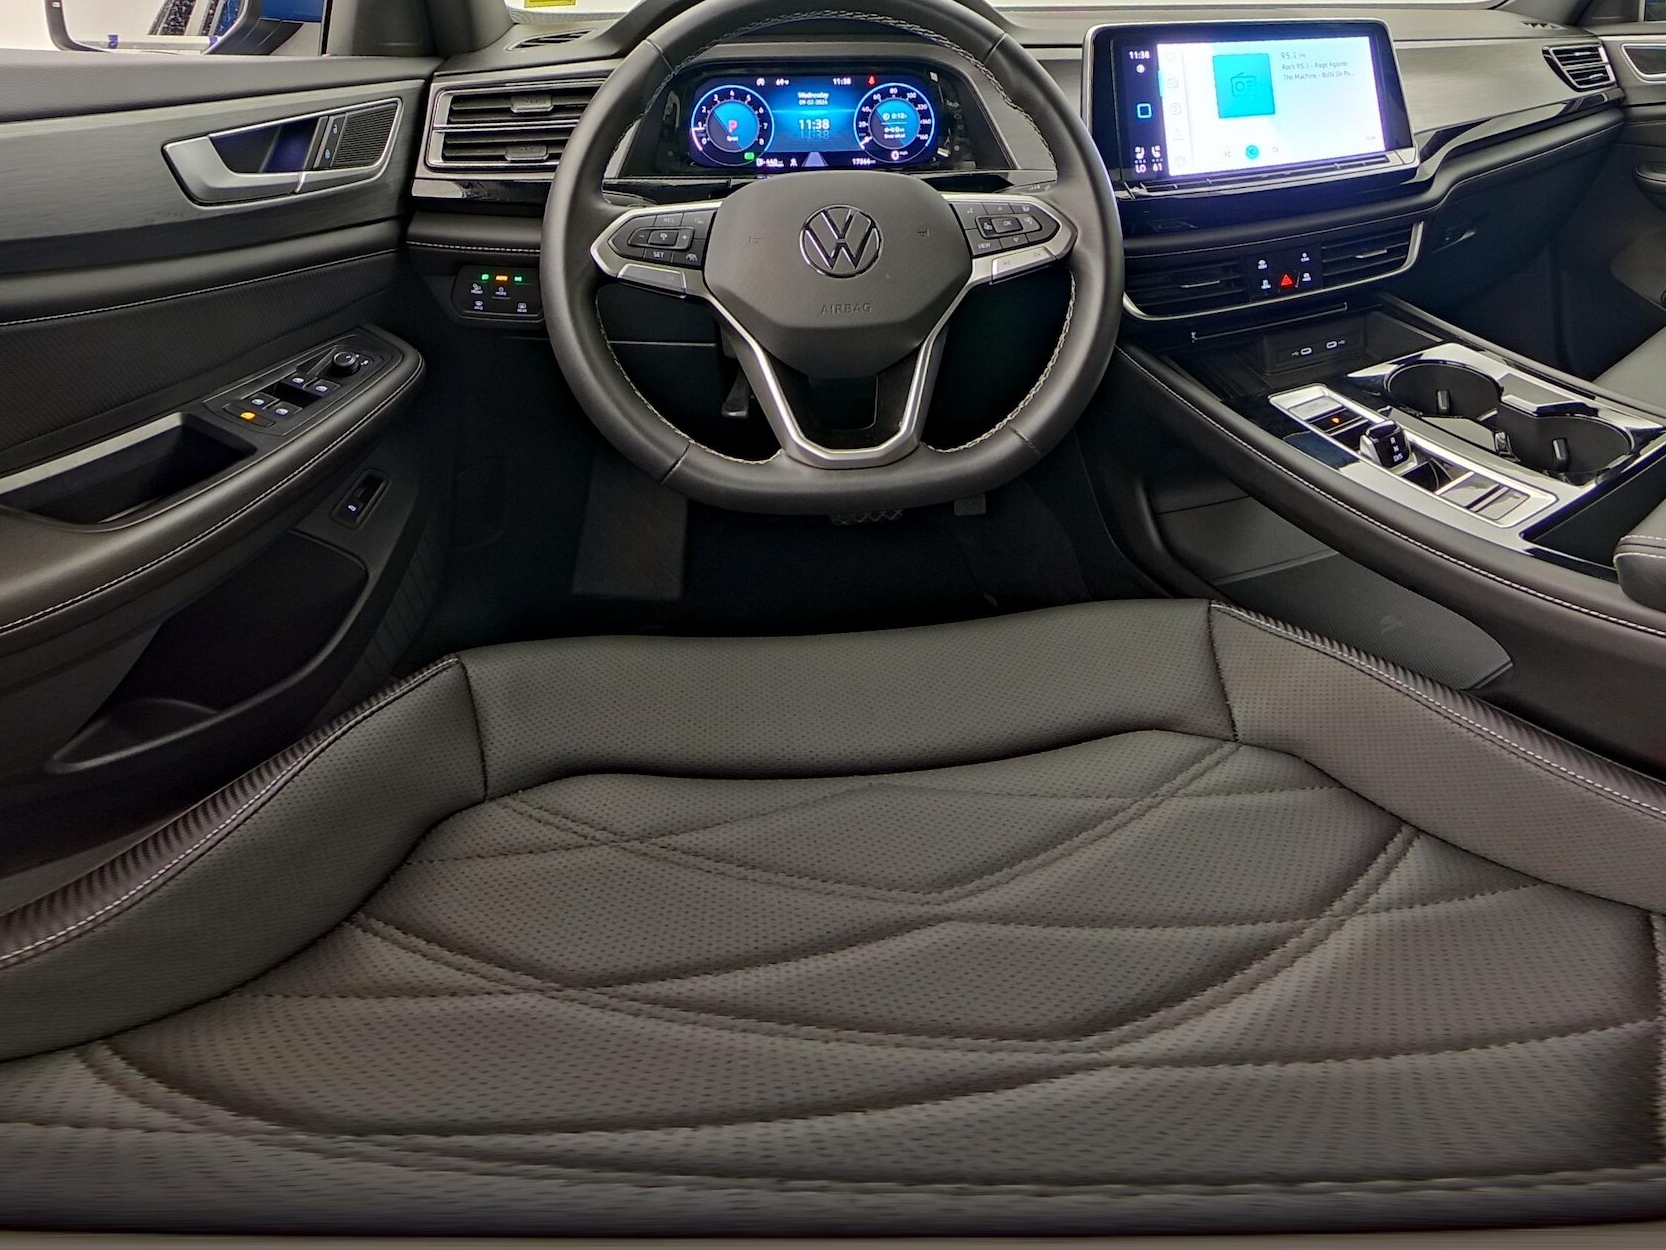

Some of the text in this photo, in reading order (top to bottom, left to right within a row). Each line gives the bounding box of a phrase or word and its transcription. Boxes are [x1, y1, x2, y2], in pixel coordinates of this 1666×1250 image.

[1129, 50, 1150, 60] 11:38
[832, 77, 852, 86] 11:38
[797, 91, 830, 100] Wednesday
[798, 118, 830, 130] 11:38
[1135, 165, 1146, 173] LO
[821, 302, 872, 315] AIRBAG
